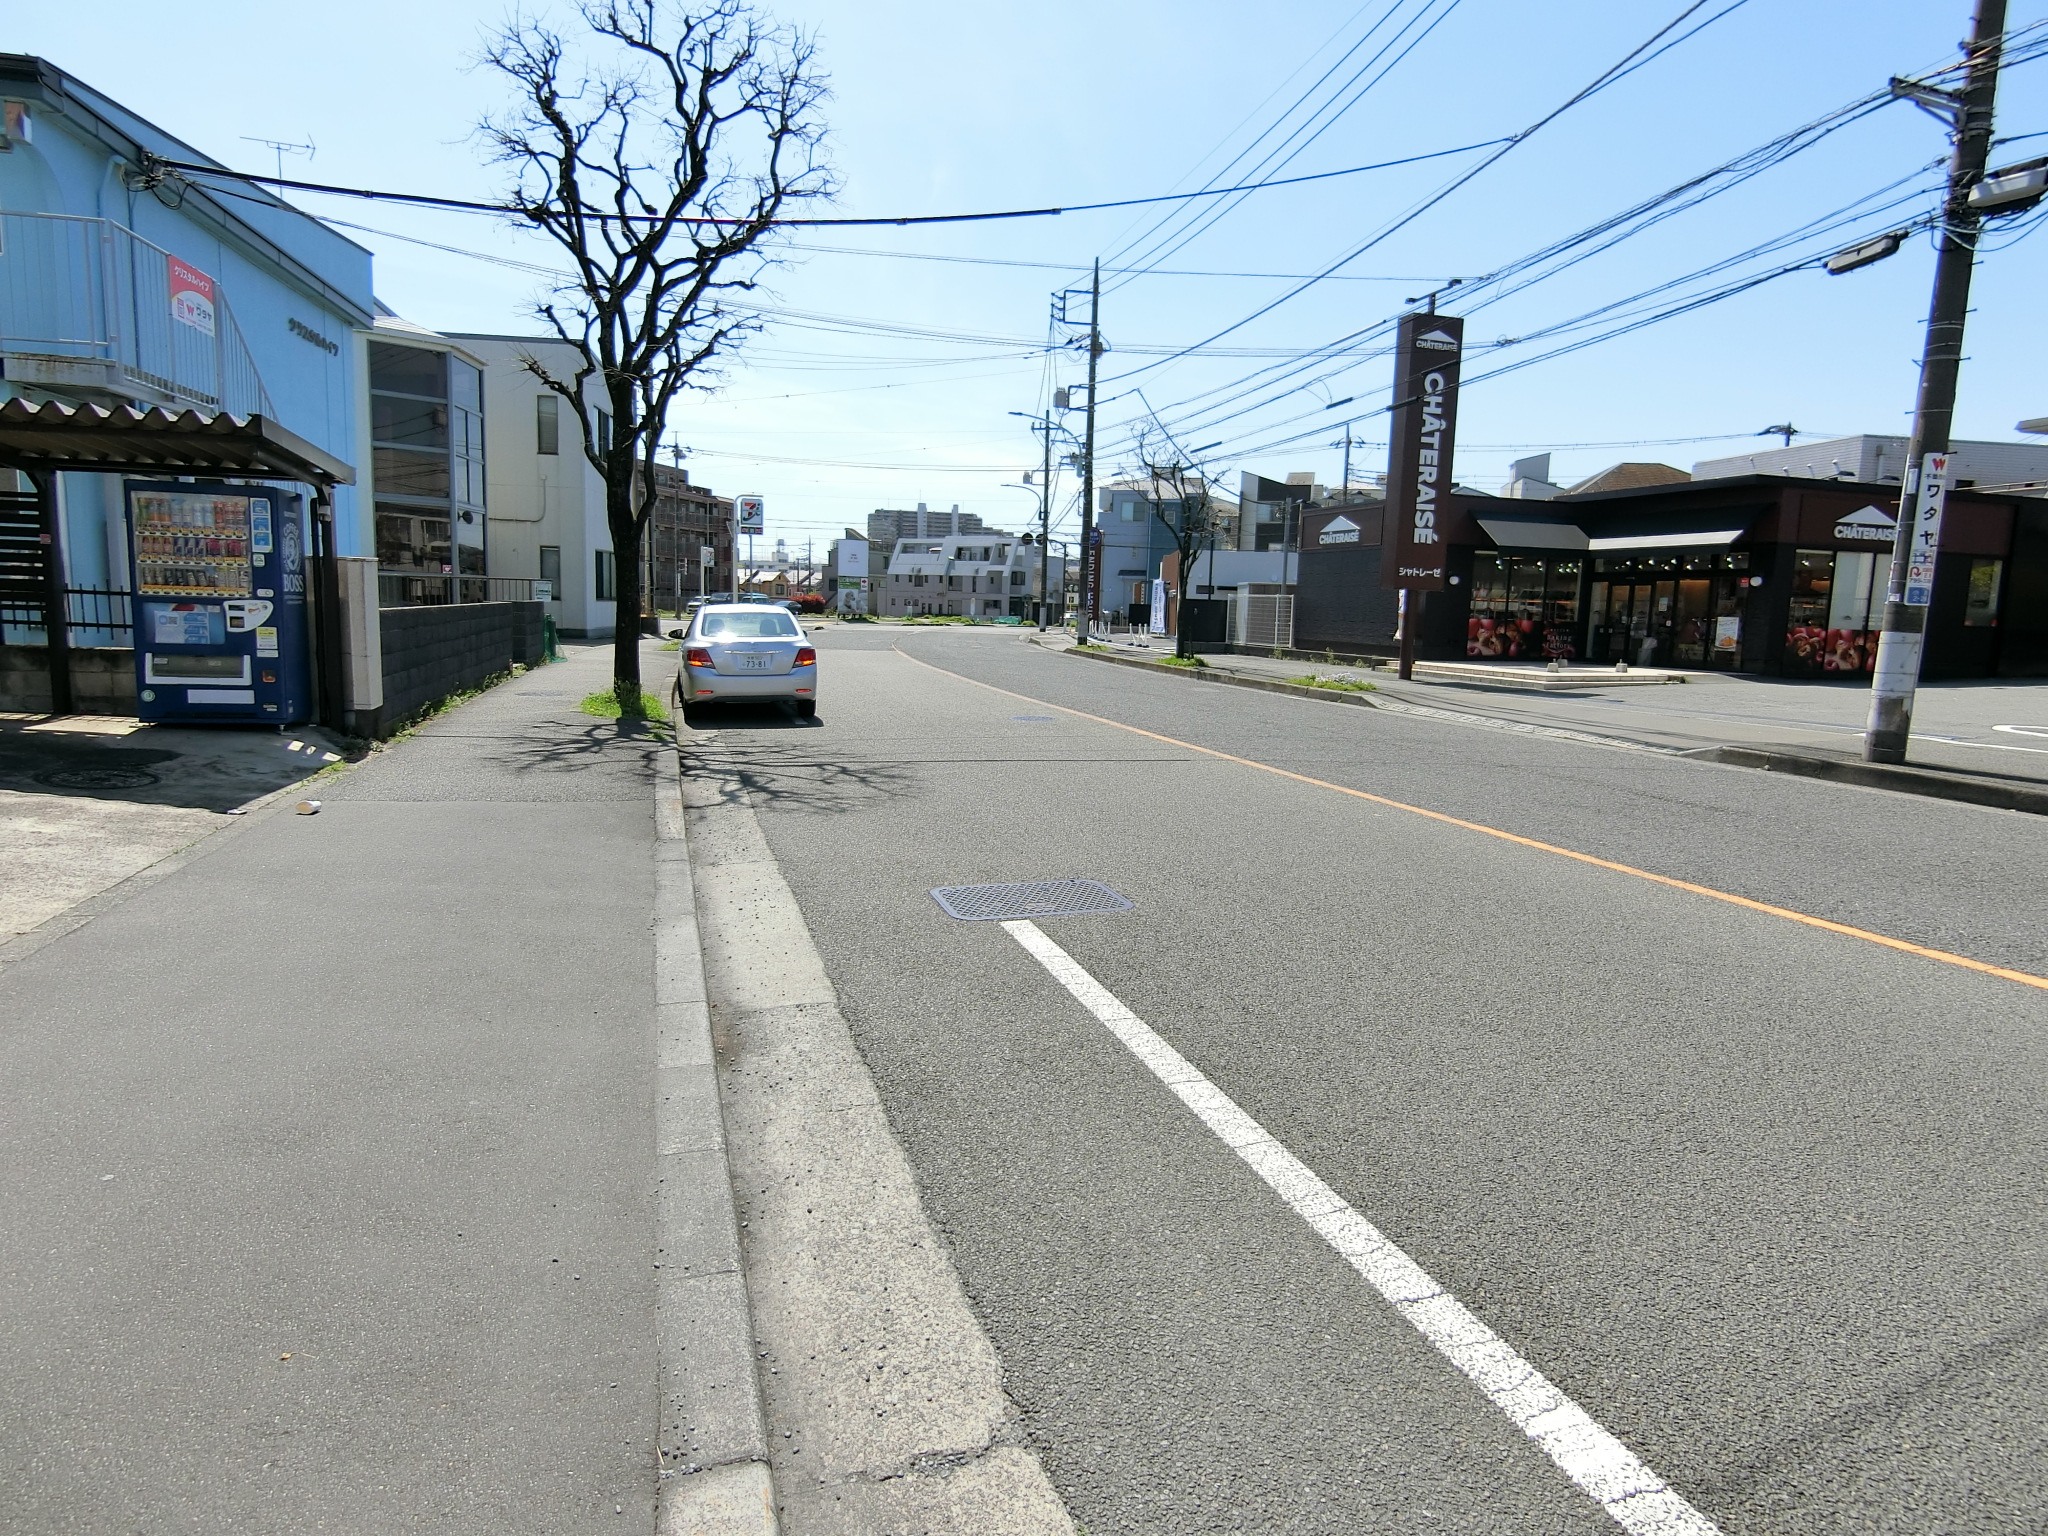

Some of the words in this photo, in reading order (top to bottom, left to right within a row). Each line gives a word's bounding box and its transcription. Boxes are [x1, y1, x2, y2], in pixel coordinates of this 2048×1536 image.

[174, 265, 210, 292] クリスタルハイツ
[196, 306, 212, 321] ワタヤ
[1413, 372, 1446, 544] CHÂTERAISÉ
[1920, 484, 1941, 545] ワタヤ
[283, 574, 304, 592] BOSS
[1398, 567, 1441, 578] シャトレーゼ
